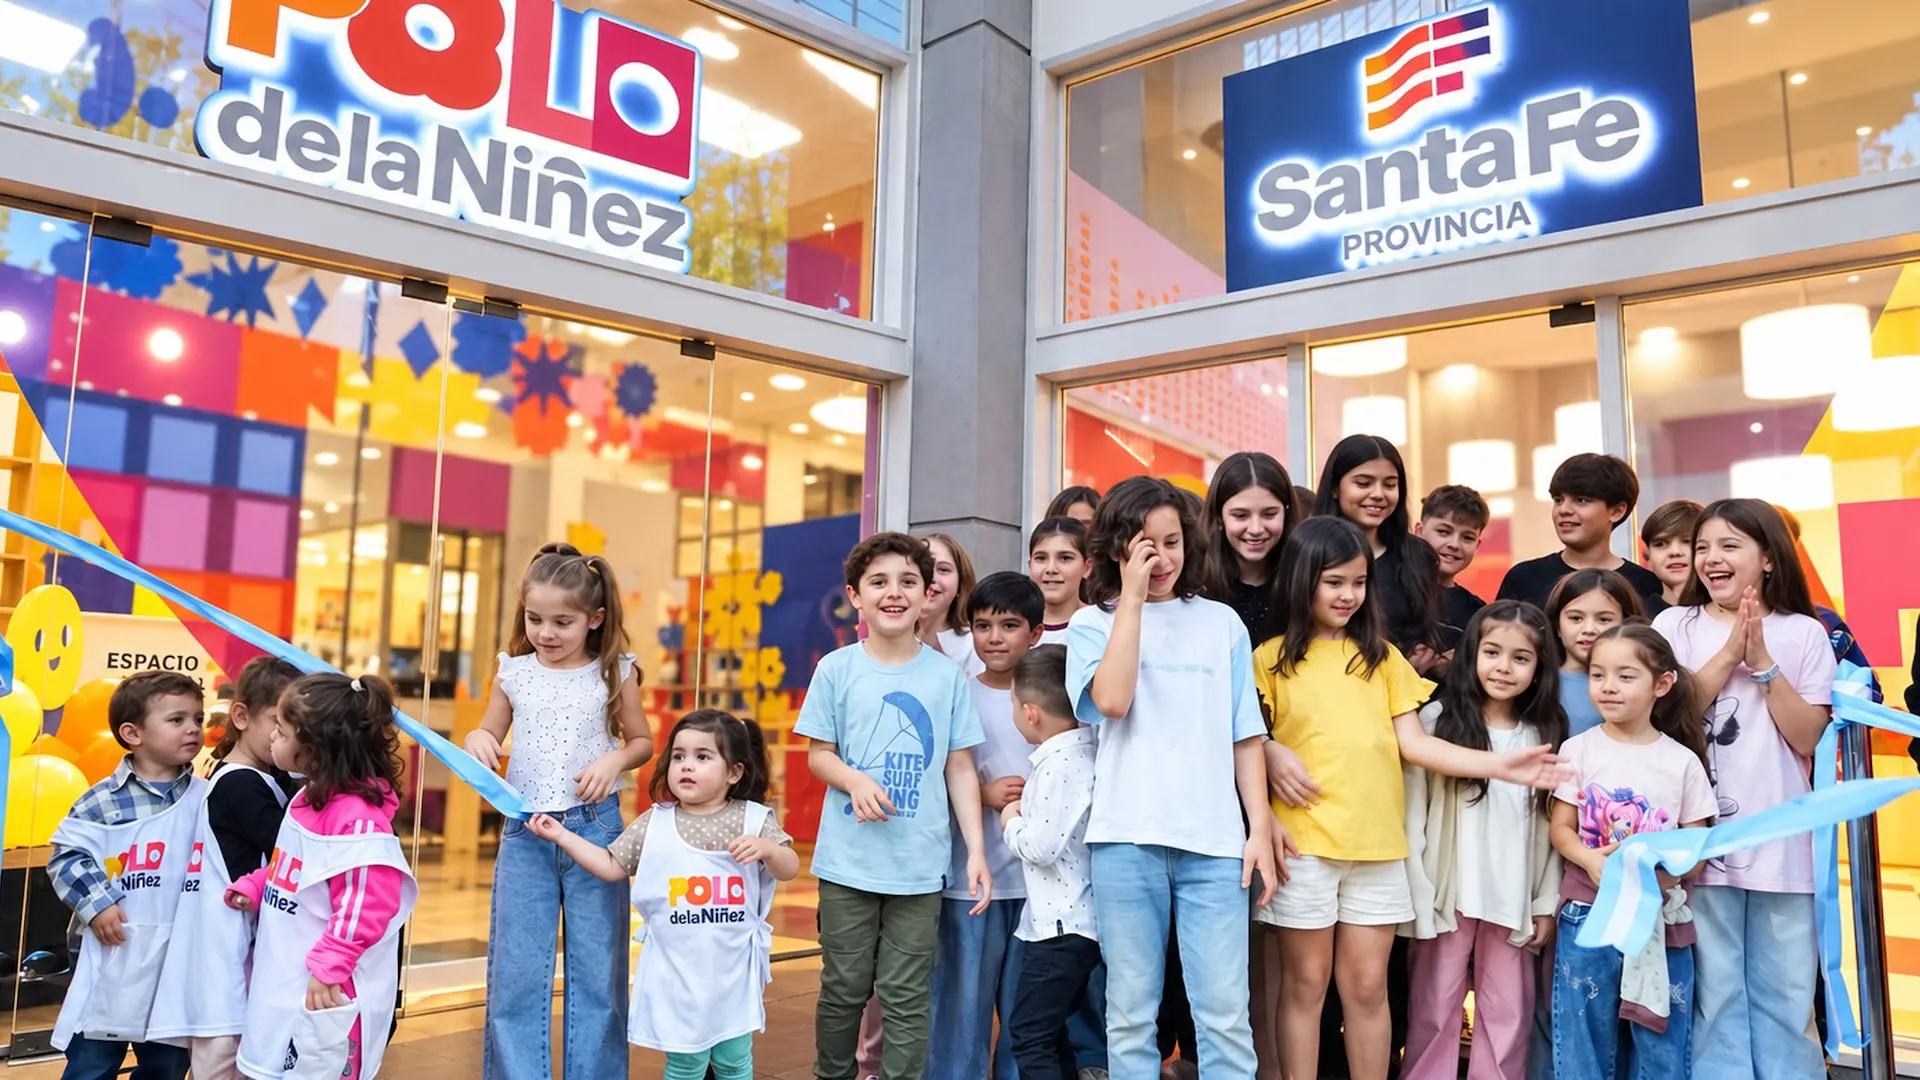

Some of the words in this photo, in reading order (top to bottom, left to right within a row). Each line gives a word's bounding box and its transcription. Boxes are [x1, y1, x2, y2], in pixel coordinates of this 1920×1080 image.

[1343, 201, 1532, 260] PROVINCIA
[107, 652, 199, 671] ESPACIO
[884, 751, 924, 771] KITE
[882, 769, 922, 788] SURF
[669, 875, 745, 908] POLO
